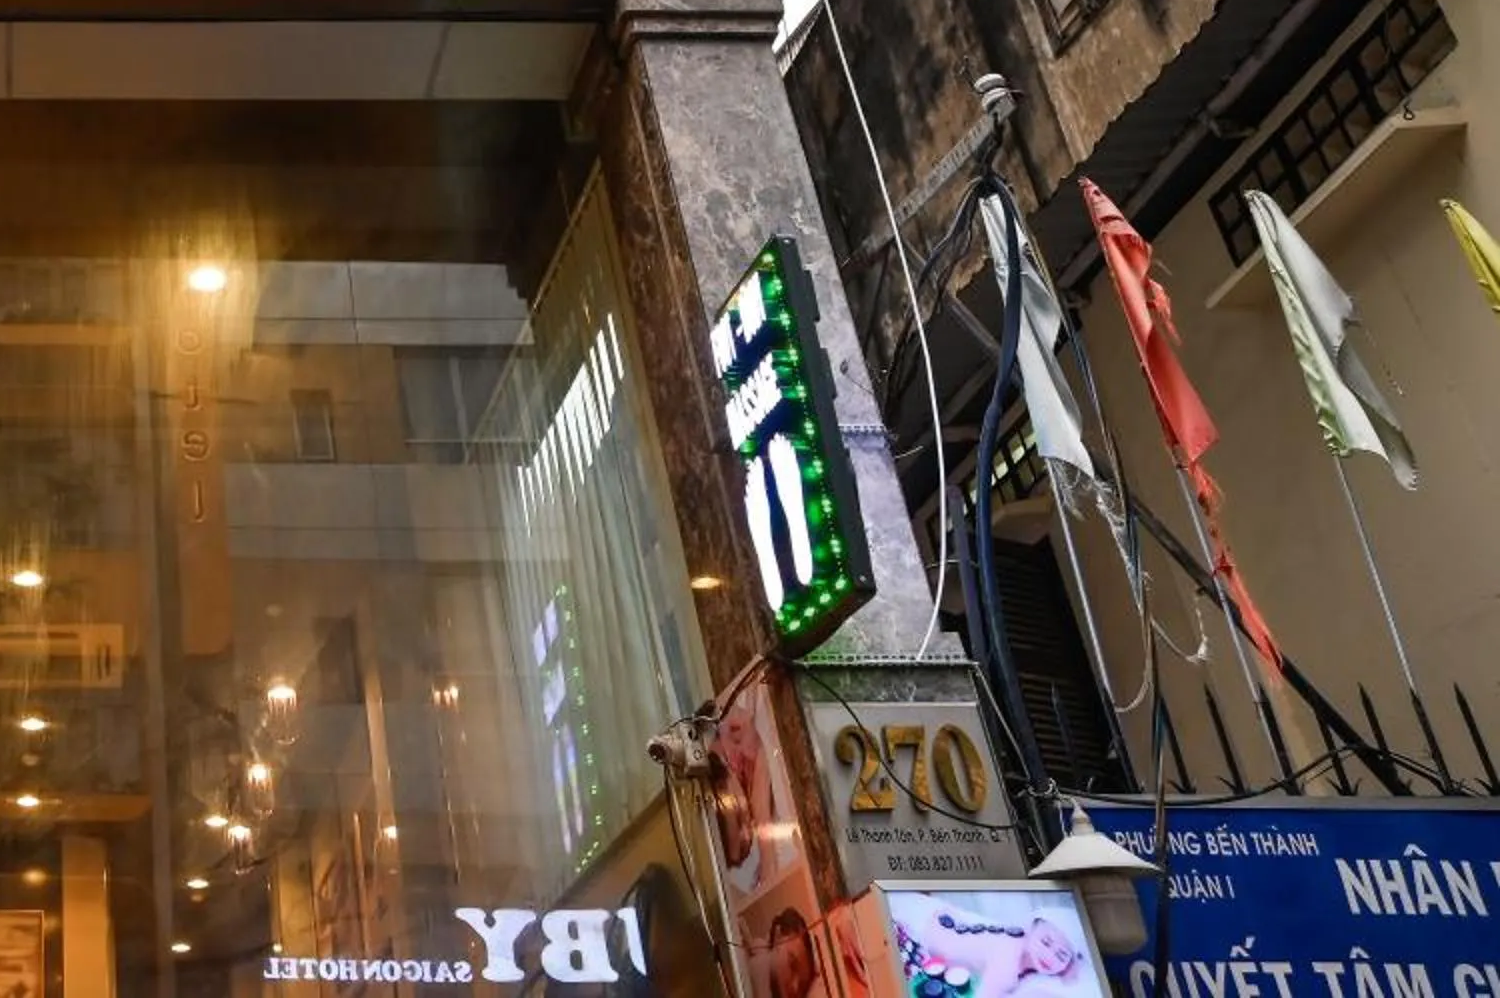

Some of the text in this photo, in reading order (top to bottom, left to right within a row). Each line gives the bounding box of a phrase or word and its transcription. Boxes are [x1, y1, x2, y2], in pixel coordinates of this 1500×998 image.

[834, 723, 988, 813] 270
[1204, 824, 1249, 856] BẾN
[1250, 825, 1320, 857] THÀNH
[1334, 843, 1489, 916] NHÂN
